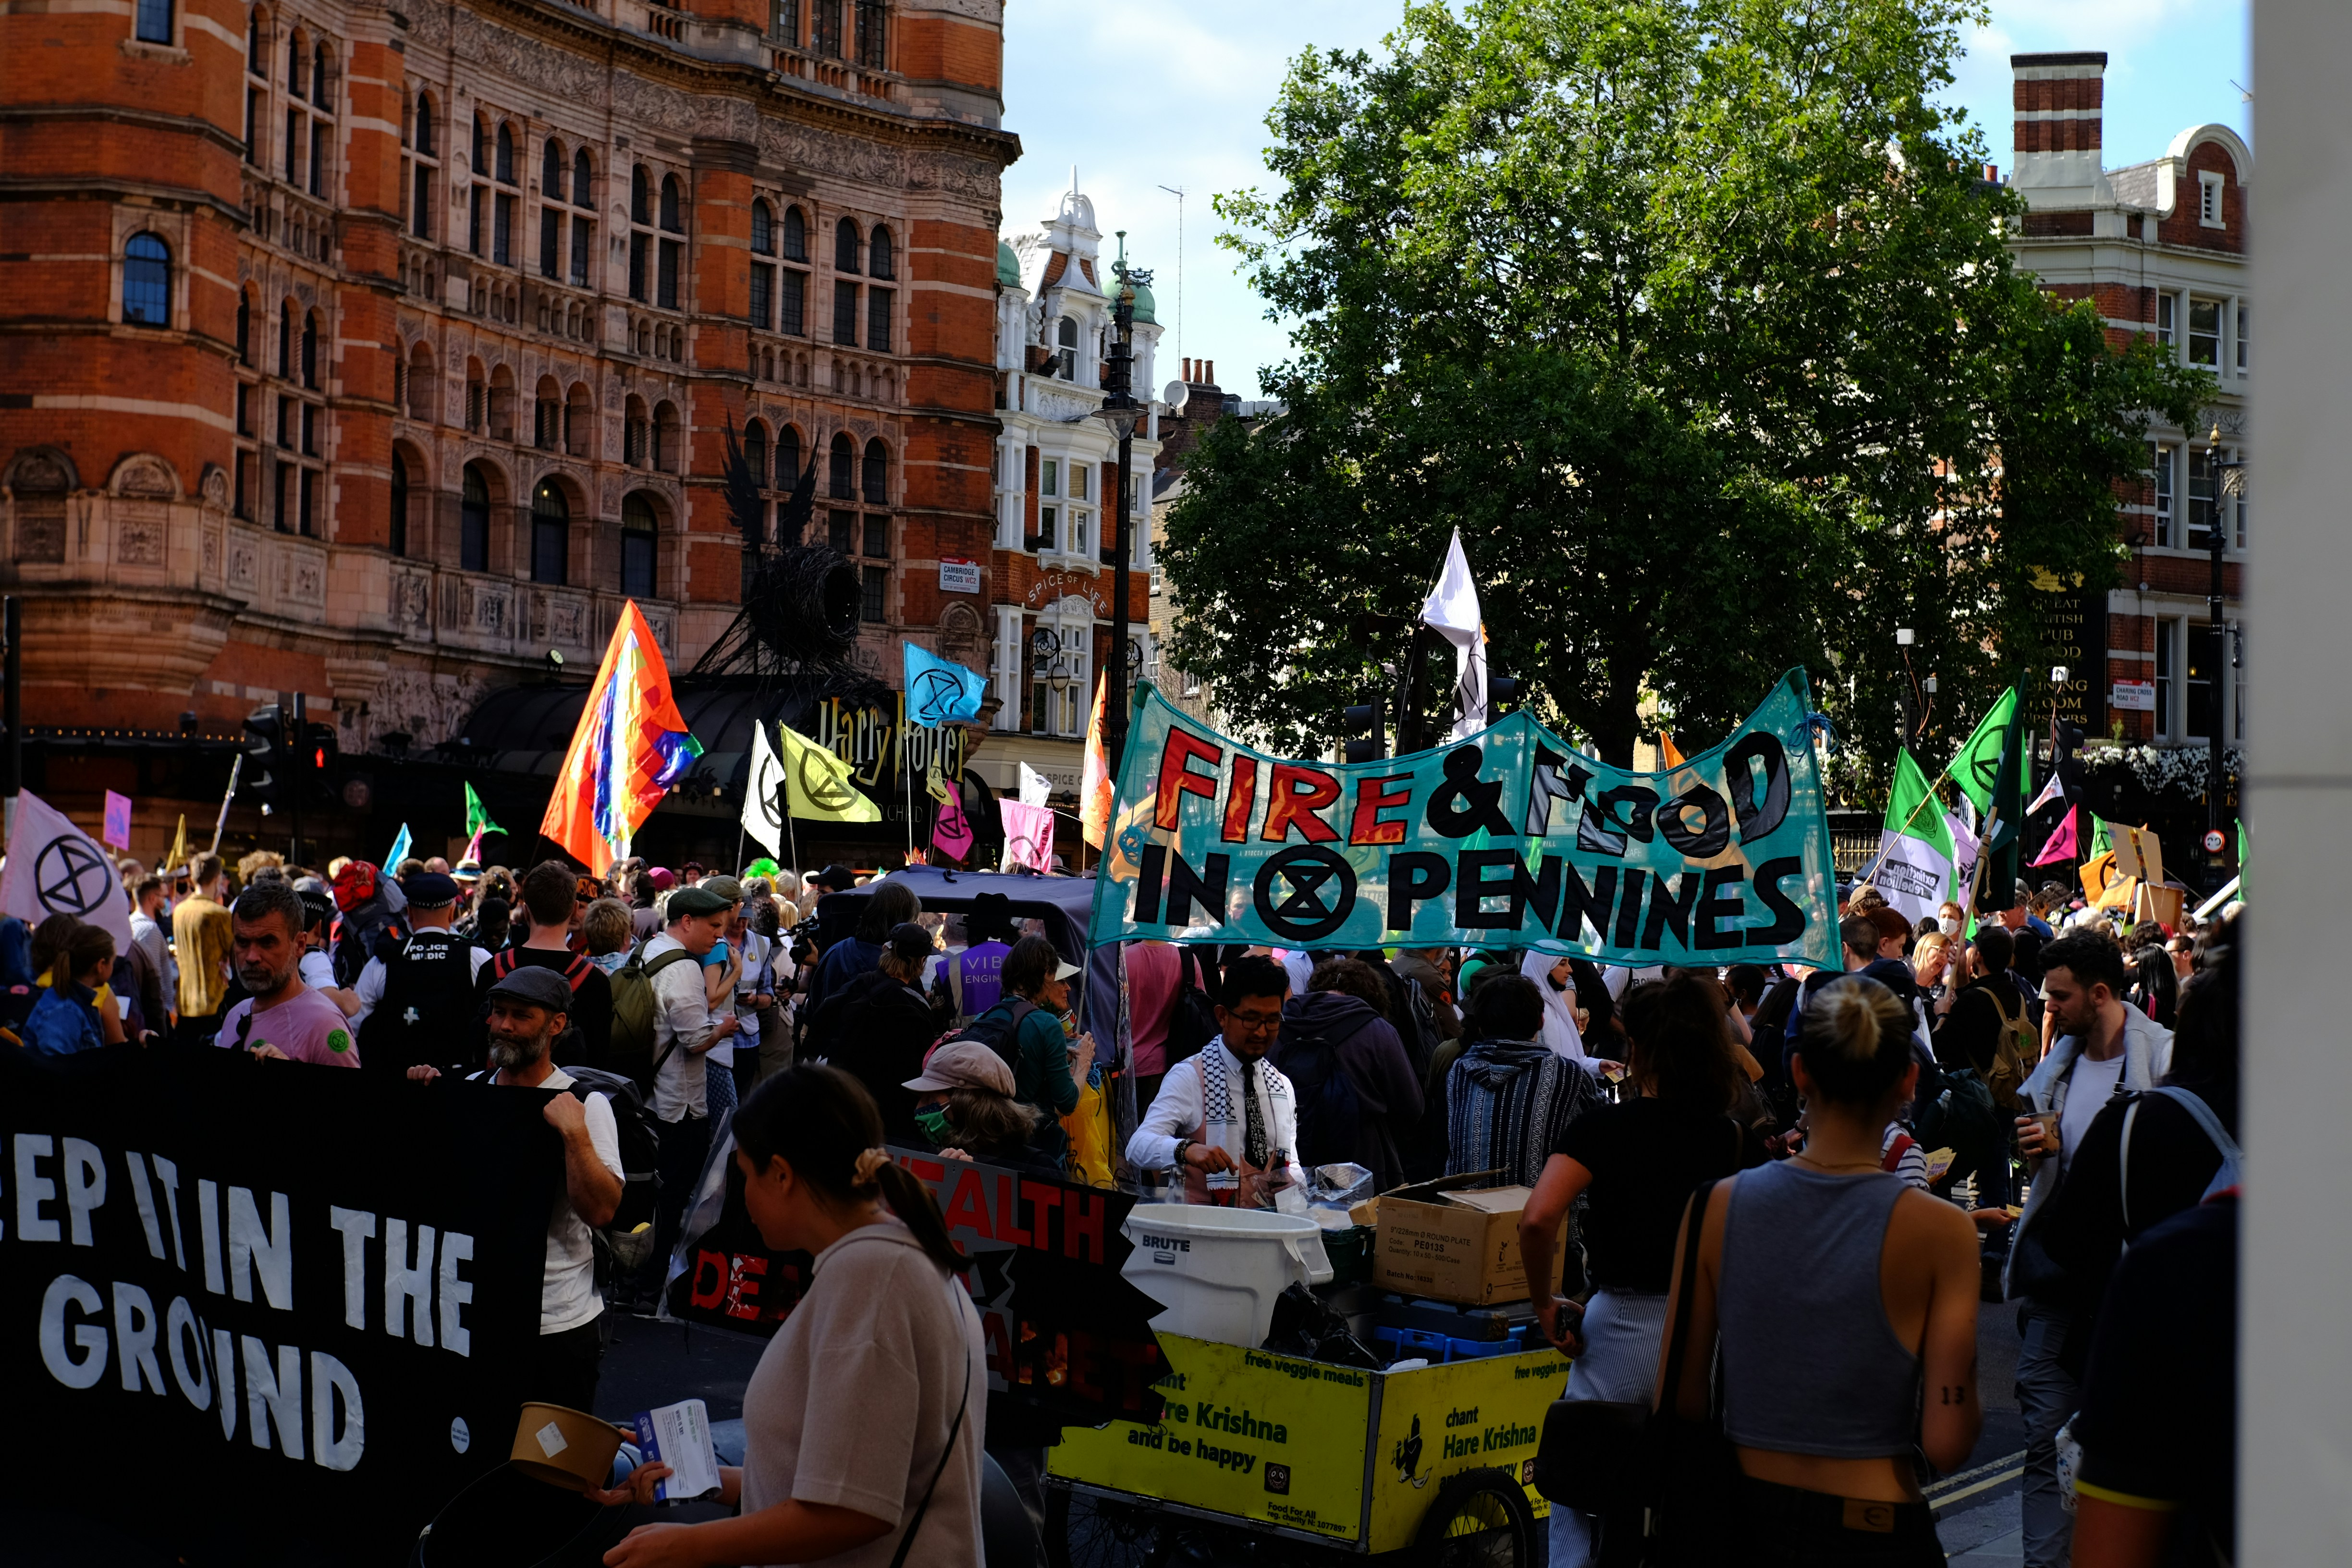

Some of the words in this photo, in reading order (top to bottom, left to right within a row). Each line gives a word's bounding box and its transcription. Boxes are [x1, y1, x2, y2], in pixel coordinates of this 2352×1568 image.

[944, 566, 975, 576] CAMBRIDGE
[944, 574, 963, 583] CIRCUS
[1029, 574, 1064, 602] SPICE
[1067, 575, 1078, 584] OF
[1082, 581, 1107, 614] LIFE
[812, 696, 892, 787] Harry
[1046, 773, 1074, 785] SPICE
[1152, 725, 1414, 846] FIRE
[1426, 743, 1516, 839] &
[1524, 731, 1792, 859] FLOOD
[1133, 844, 1230, 927] IN
[1387, 848, 1806, 951] PENNINES
[1143, 1234, 1190, 1252] BRUTE
[1389, 1237, 1405, 1246] Code:
[1414, 1240, 1445, 1253] PE013S
[1425, 1233, 1450, 1243] ROUND
[1451, 1237, 1471, 1247] PLATE
[125, 1151, 186, 1272] IT
[198, 1178, 293, 1311] IN
[330, 1204, 474, 1358] THE
[1388, 1246, 1412, 1257] Quantity:
[1435, 1253, 1460, 1265] 500/Case
[1386, 1270, 1404, 1279] Batch
[1417, 1274, 1433, 1284] 16330
[39, 1274, 365, 1471] GROUND
[1245, 1351, 1272, 1369] free
[1274, 1360, 1320, 1380] veggie
[1323, 1372, 1364, 1387] meals
[1514, 1365, 1530, 1379] free
[1532, 1360, 1556, 1379] veggie
[1941, 1385, 1965, 1405] 13
[1196, 1401, 1287, 1444] Krishna
[1446, 1406, 1479, 1428] chant
[1443, 1433, 1479, 1459] Hare
[1483, 1422, 1536, 1452] Krishna
[1128, 1430, 1163, 1450] and
[1168, 1433, 1191, 1456] be
[1197, 1438, 1256, 1474] happy
[1267, 1510, 1280, 1520] reg.
[1282, 1513, 1306, 1526] charity
[1317, 1520, 1346, 1533] 1077897
[1268, 1502, 1288, 1513] Food
[1290, 1506, 1303, 1516] For
[1305, 1510, 1316, 1519] All
